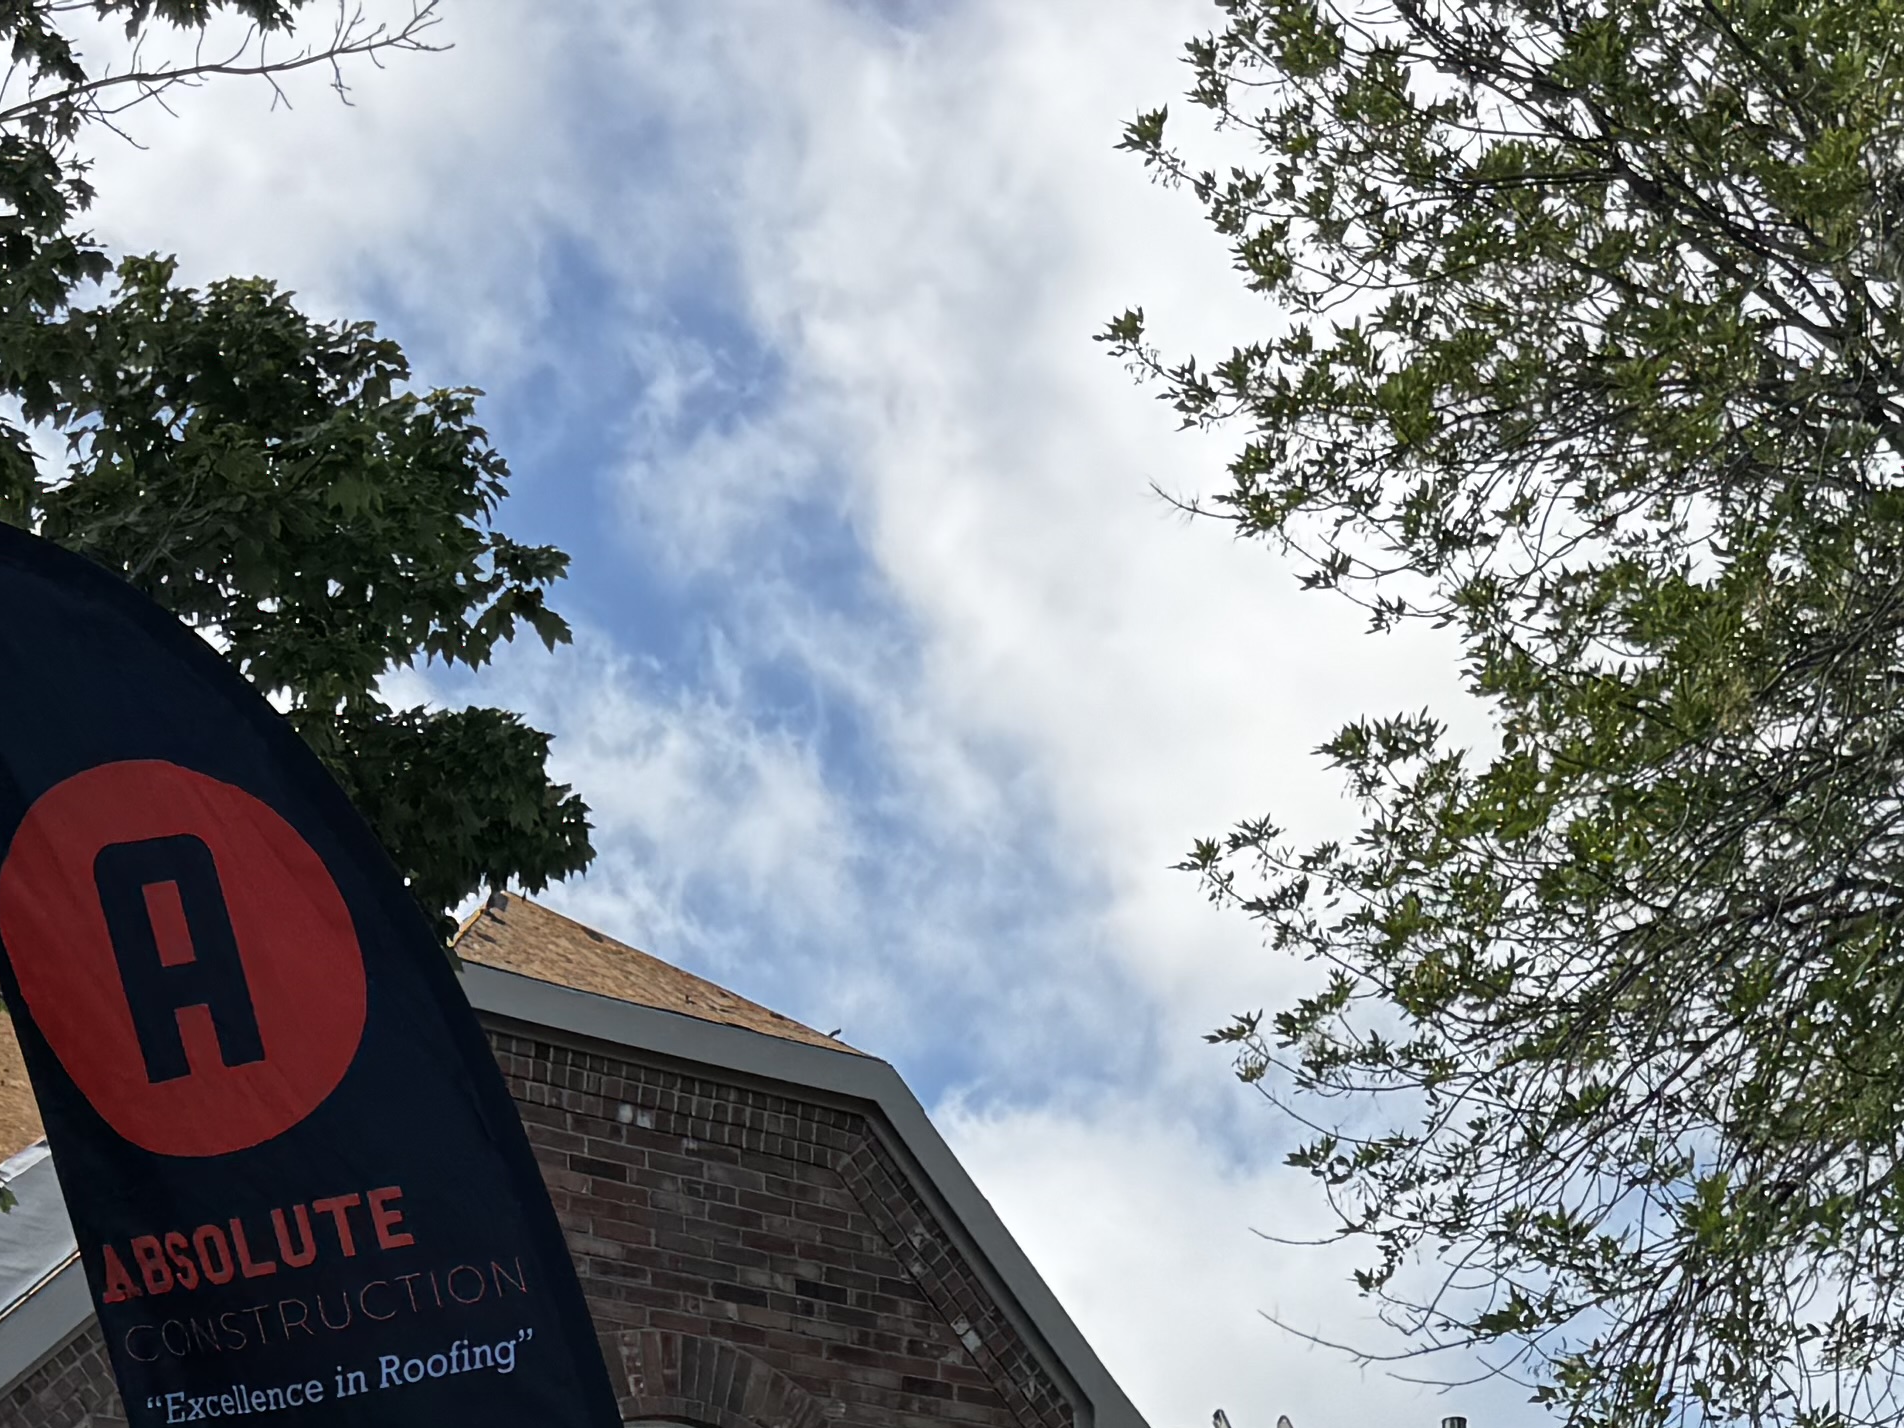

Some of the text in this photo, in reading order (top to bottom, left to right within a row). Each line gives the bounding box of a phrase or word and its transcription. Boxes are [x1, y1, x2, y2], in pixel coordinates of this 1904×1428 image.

[94, 833, 265, 1083] A
[101, 1186, 414, 1303] ABSOLUTE
[125, 1256, 526, 1362] CONSTRUCTION
[335, 1365, 368, 1398] in
